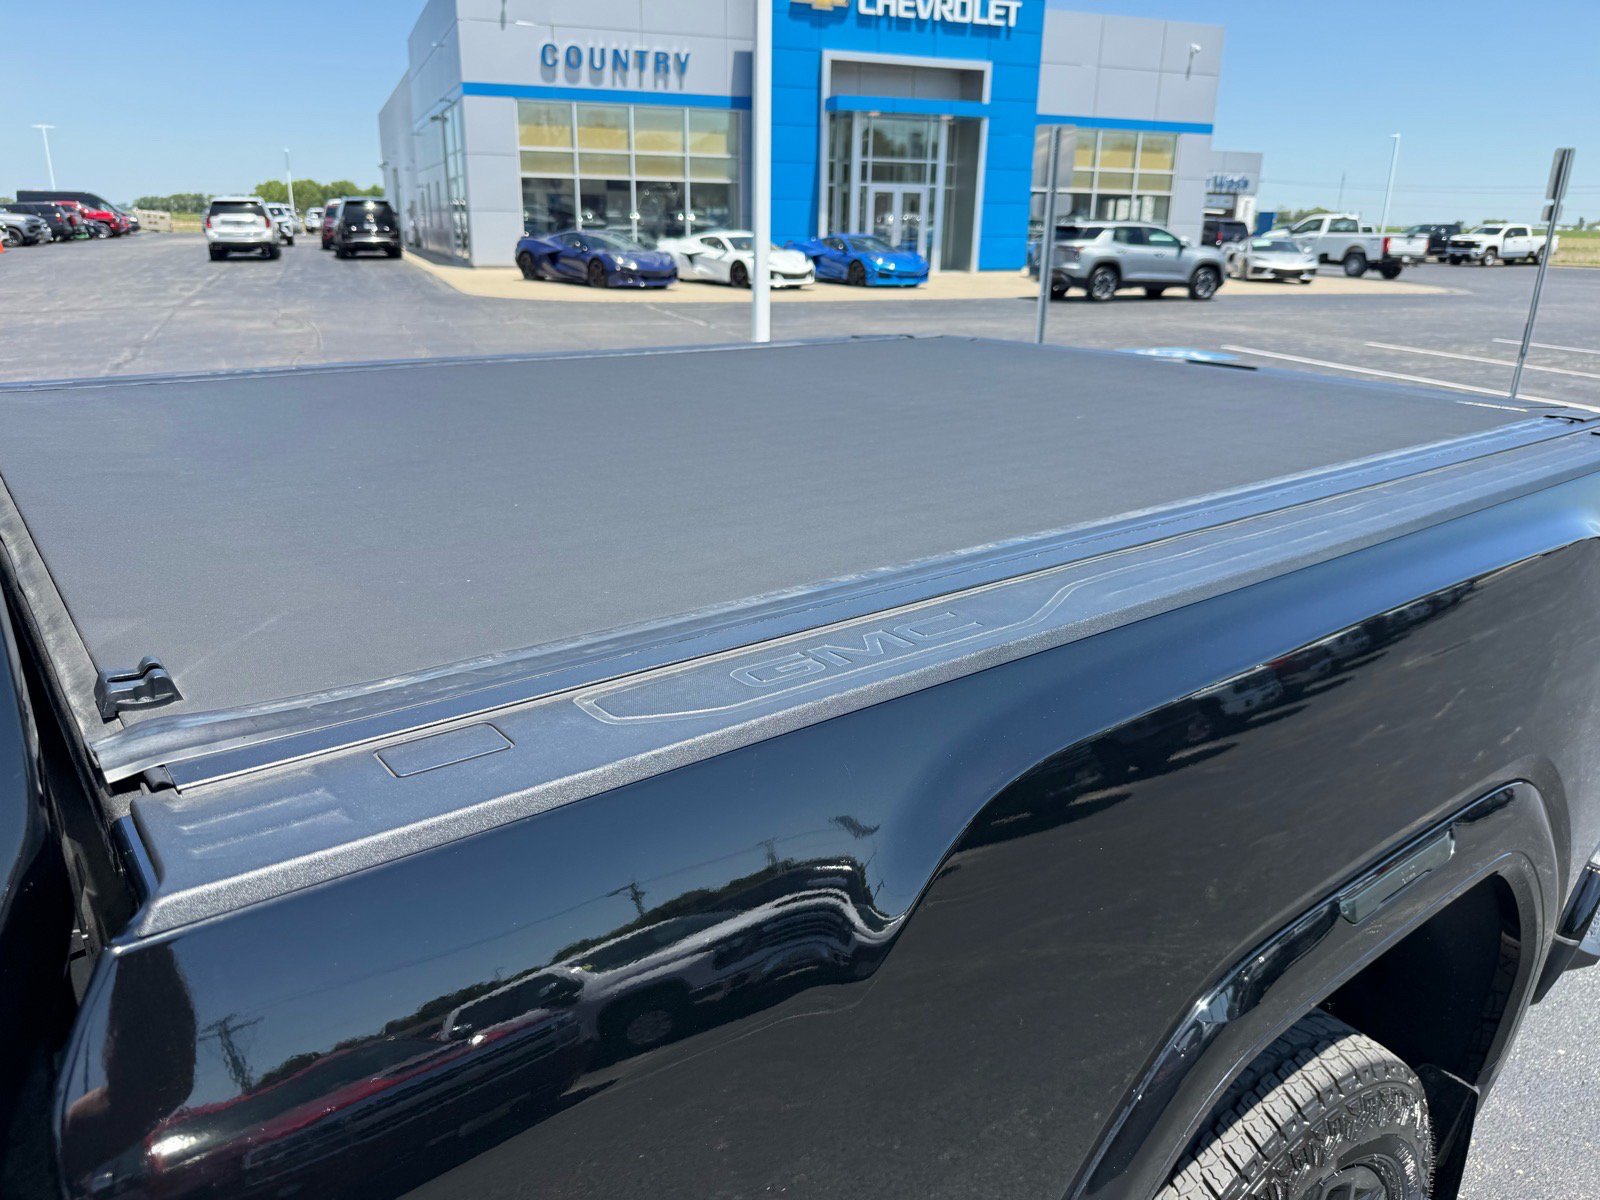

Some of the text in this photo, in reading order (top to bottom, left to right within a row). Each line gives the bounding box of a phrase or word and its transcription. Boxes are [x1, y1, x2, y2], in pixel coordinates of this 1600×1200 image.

[857, 0, 1022, 27] CHEVROLET
[541, 43, 690, 76] COUNTRY
[730, 612, 984, 687] GMC
